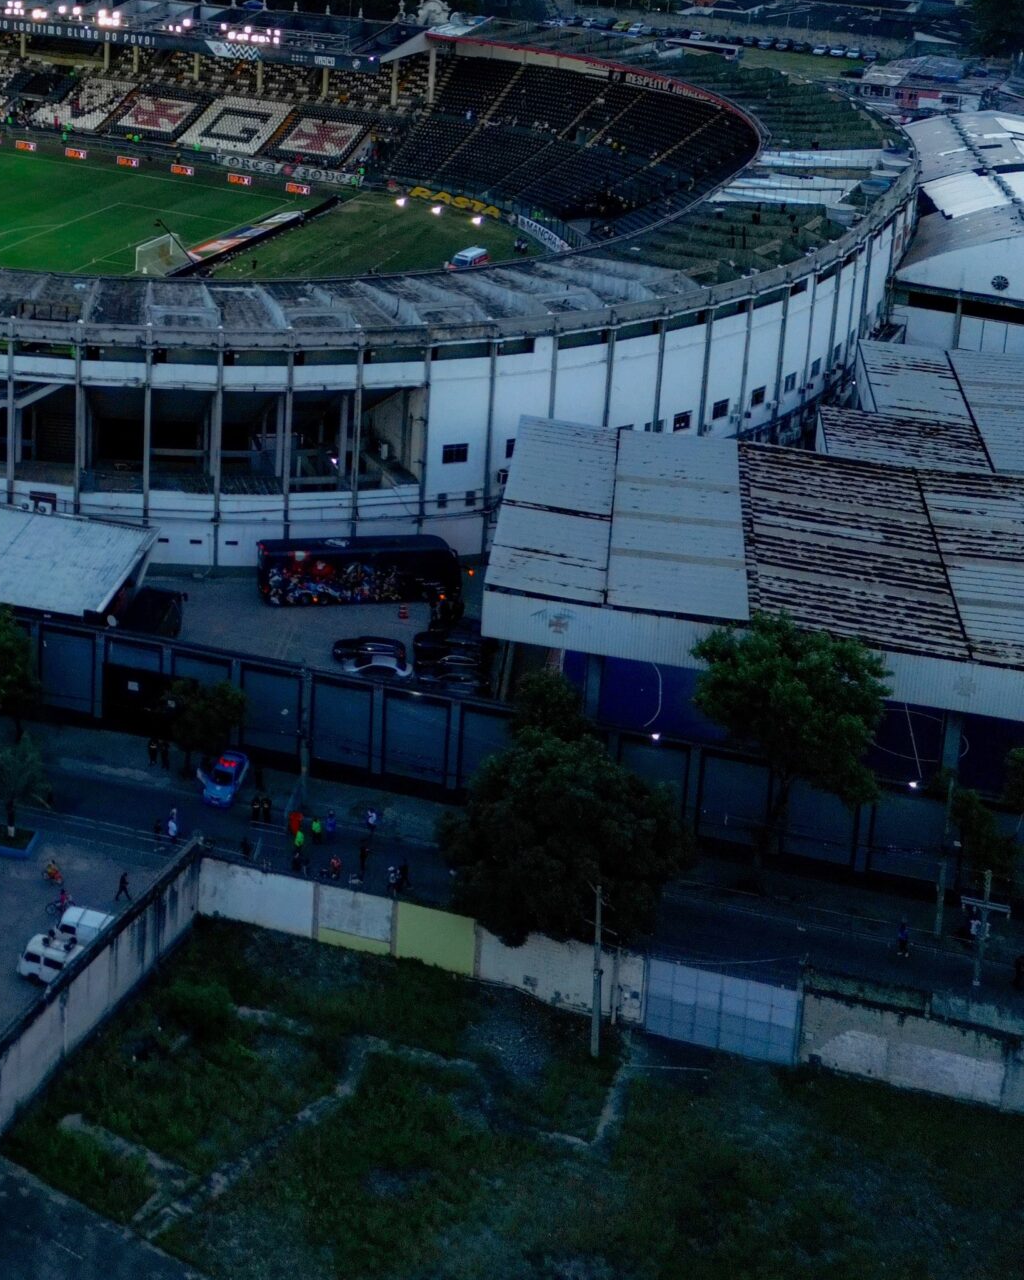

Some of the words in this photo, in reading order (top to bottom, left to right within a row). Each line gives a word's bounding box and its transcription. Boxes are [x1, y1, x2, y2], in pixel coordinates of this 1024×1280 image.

[67, 27, 99, 40] CLUBE
[104, 32, 117, 42] DO
[314, 55, 336, 67] VASCO
[409, 186, 502, 219] RASTA
